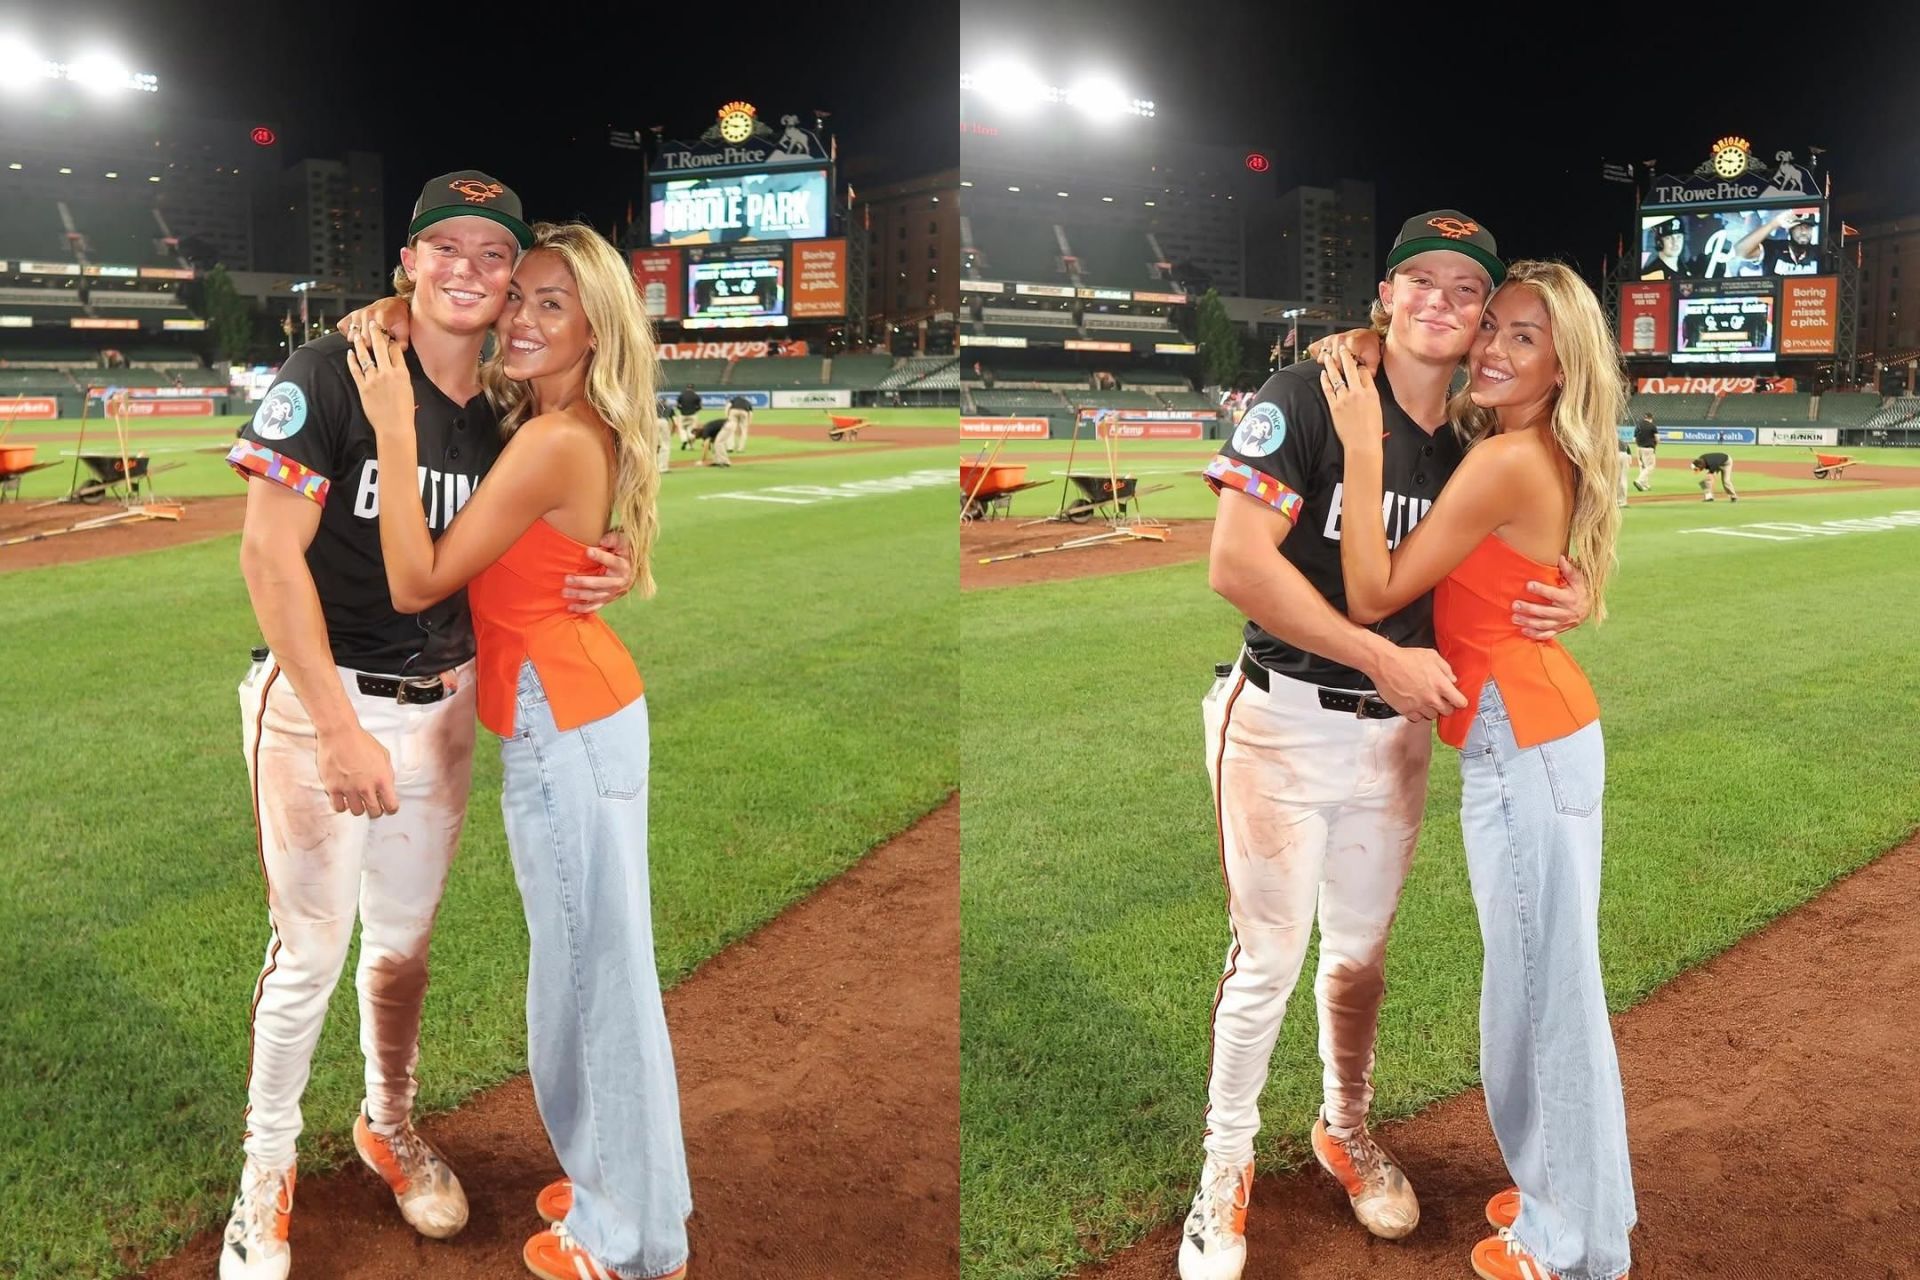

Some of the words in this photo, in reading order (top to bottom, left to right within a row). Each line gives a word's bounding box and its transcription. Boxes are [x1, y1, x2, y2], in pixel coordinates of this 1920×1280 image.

[1711, 136, 1750, 153] ORIOLES
[664, 196, 743, 232] ORIOLE
[747, 190, 812, 229] PARK
[1793, 287, 1826, 299] Boring
[1795, 299, 1824, 307] never
[1792, 306, 1826, 316] misses
[1799, 316, 1829, 328] pitch.
[1268, 408, 1281, 431] Price
[1684, 432, 1716, 440] MedStar
